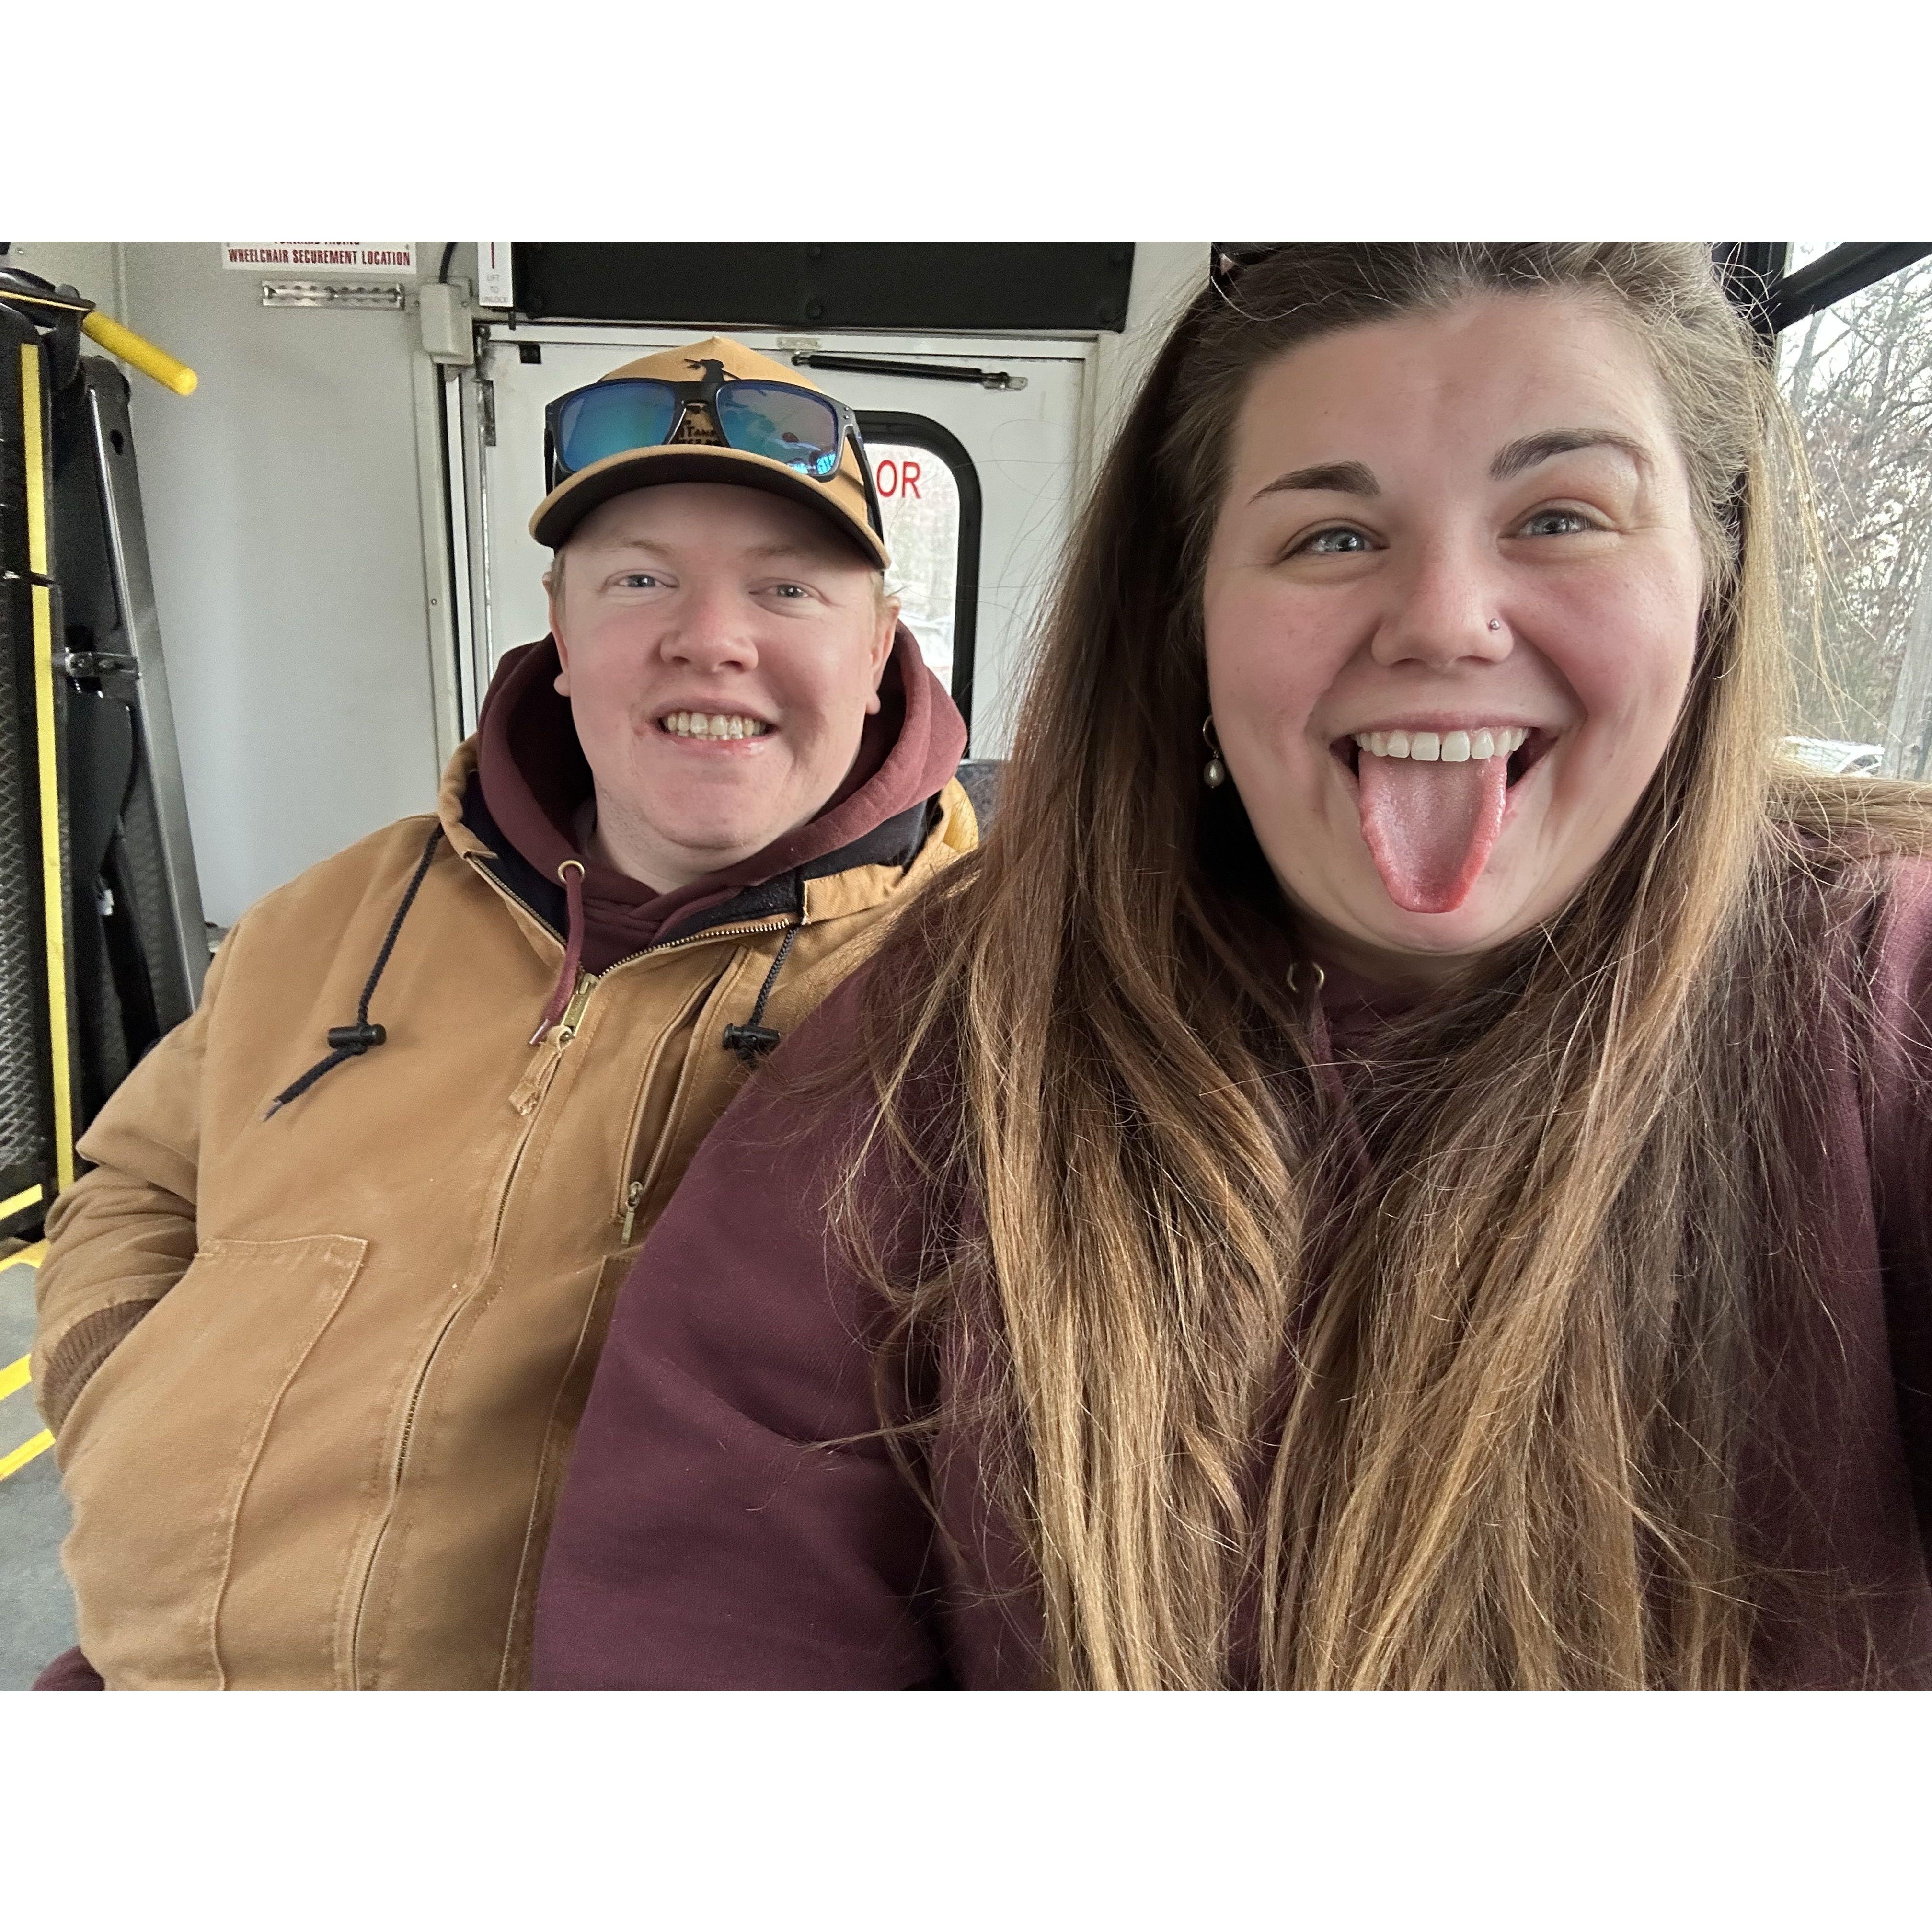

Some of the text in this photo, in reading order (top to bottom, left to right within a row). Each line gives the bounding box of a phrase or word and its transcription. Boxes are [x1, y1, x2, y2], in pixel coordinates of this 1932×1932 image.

[228, 249, 410, 266] WHEELCHAIR SECUREMENT LOCATION
